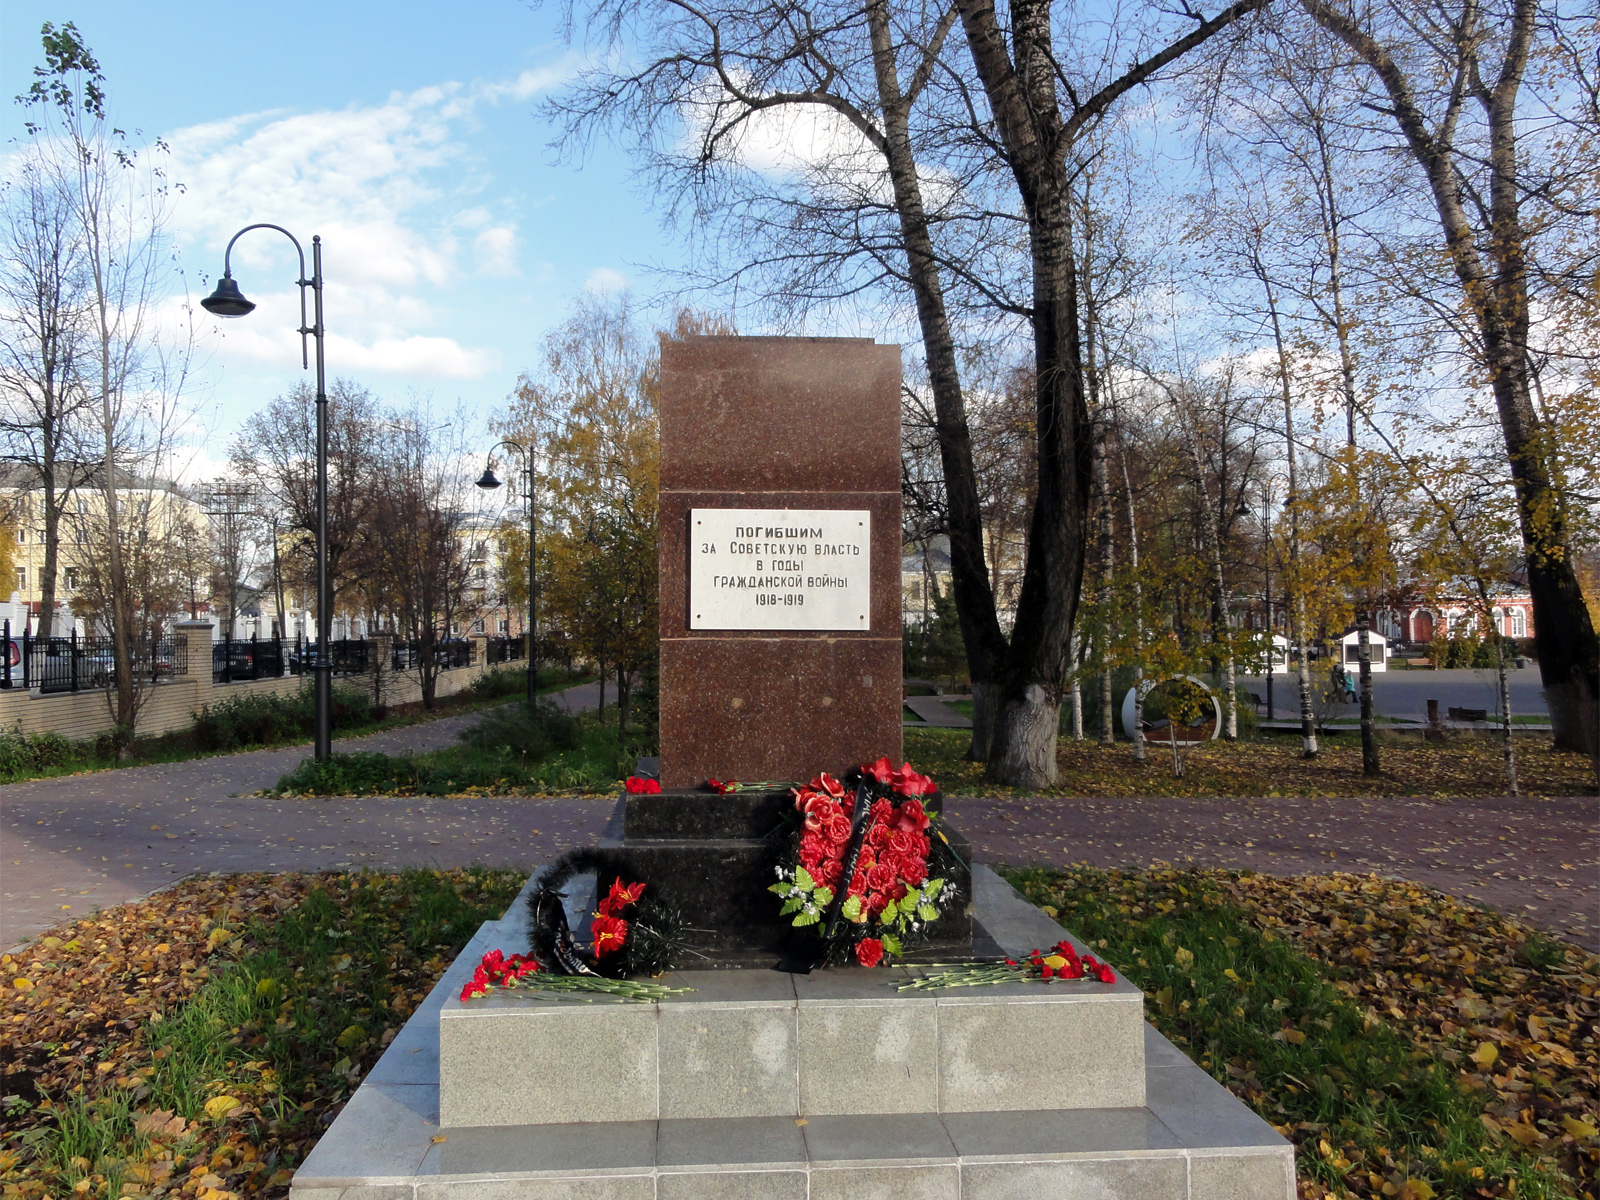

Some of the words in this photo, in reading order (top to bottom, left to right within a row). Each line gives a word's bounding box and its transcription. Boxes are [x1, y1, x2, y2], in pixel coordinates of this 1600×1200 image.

[735, 526, 823, 538] ПОГИБШИМ
[701, 543, 717, 554] ЗА
[729, 541, 807, 555] СОВЕТСКУЮ
[814, 544, 860, 556] ВЛАСТЬ
[756, 560, 763, 571] В
[772, 560, 804, 571] ГОДЫ
[713, 574, 803, 588] ГРАЖДАНСКОЙ
[807, 573, 848, 588] ВОЙНЫ
[755, 594, 804, 606] 1918-1919
